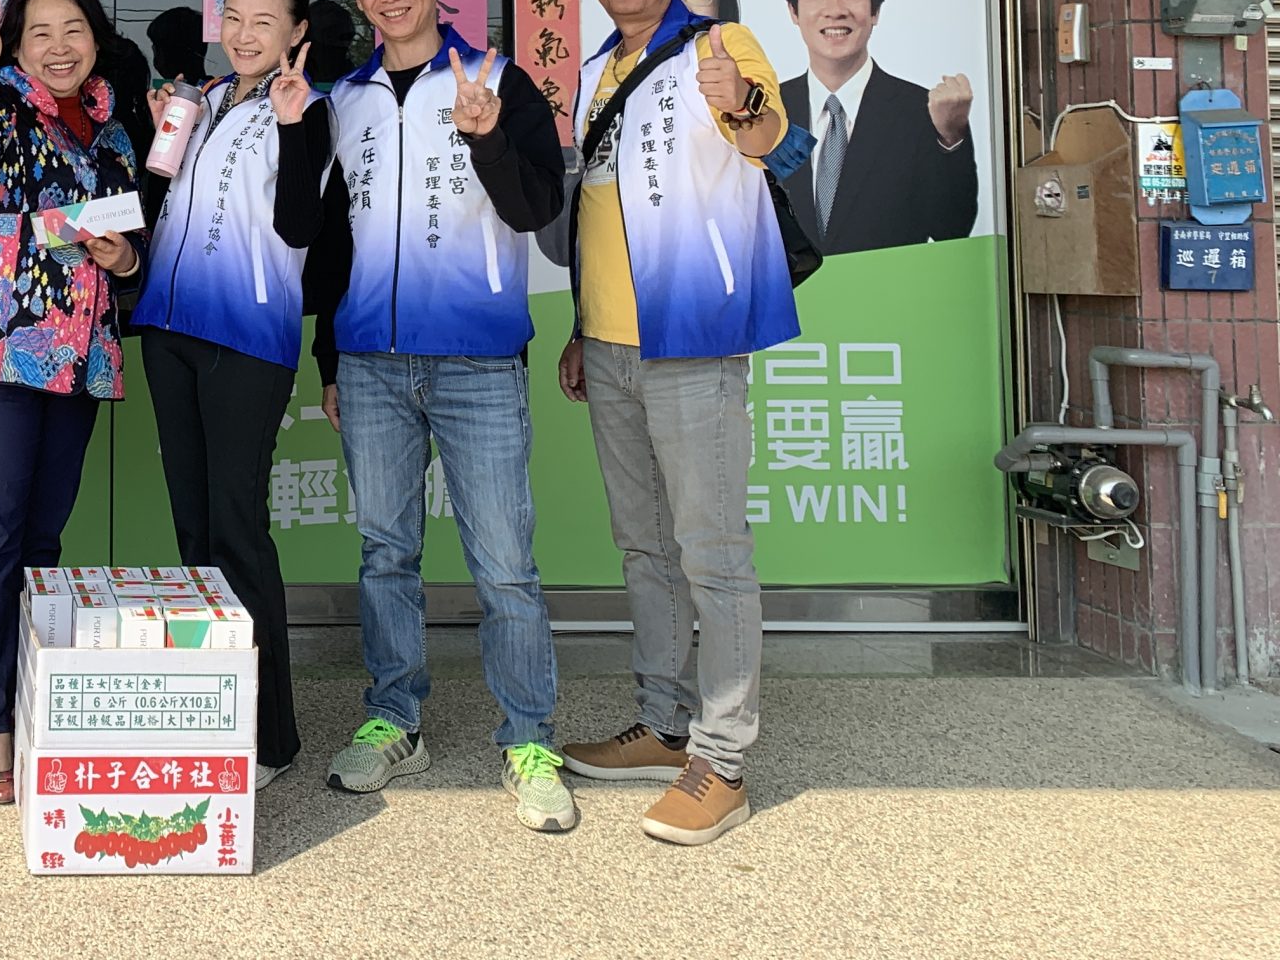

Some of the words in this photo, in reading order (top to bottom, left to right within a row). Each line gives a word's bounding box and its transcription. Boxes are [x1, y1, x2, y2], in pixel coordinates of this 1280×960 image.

[658, 96, 676, 155] 佑昌宮
[360, 126, 376, 211] 主任委員
[448, 130, 469, 195] 佑昌宮
[641, 122, 664, 207] 管理委員會
[425, 157, 442, 249] 管理委員會
[1176, 248, 1246, 269] 巡邏箱
[746, 394, 910, 470] 要贏
[785, 485, 907, 523] WIN!
[93, 616, 101, 648] PORTA
[54, 696, 78, 709] 重量
[55, 678, 79, 690] 品種
[54, 714, 79, 727] 等級
[87, 714, 125, 727] 特級品
[134, 715, 159, 727] 規格
[167, 714, 177, 726] 大
[186, 714, 196, 727] 中
[205, 715, 215, 726] 小
[74, 760, 215, 790] 朴子合作社
